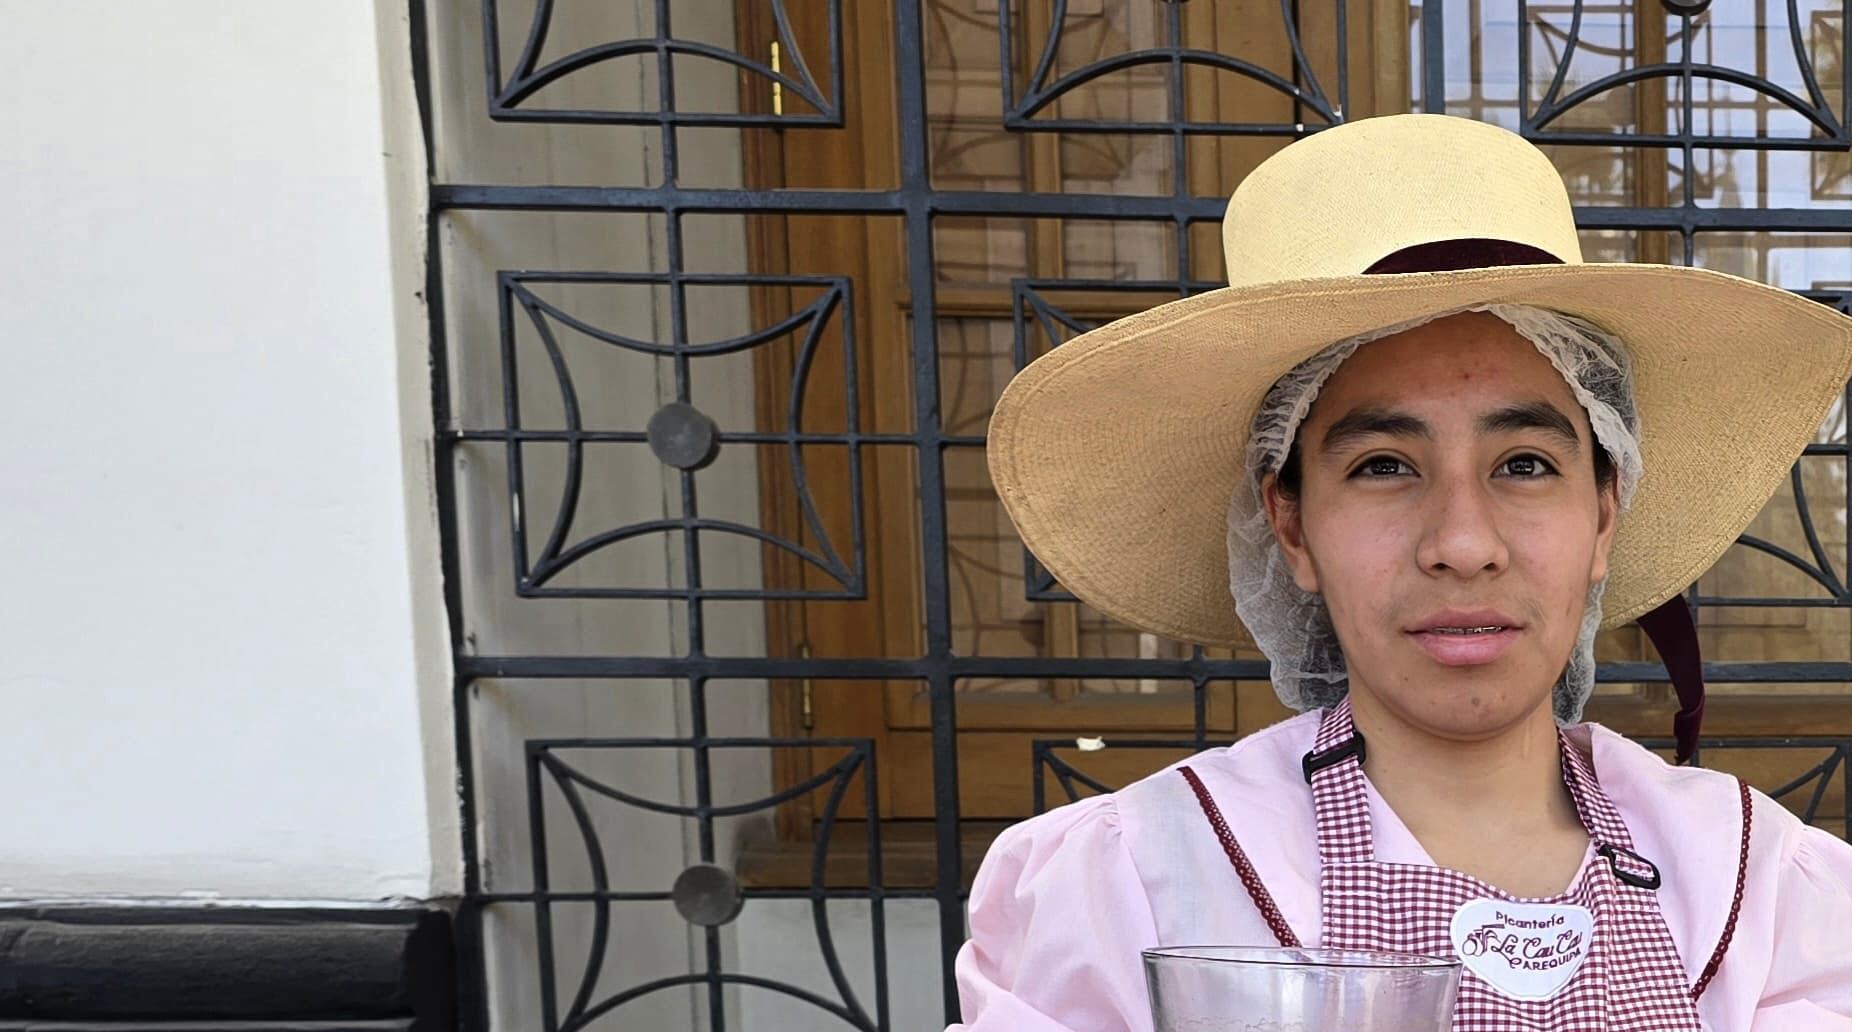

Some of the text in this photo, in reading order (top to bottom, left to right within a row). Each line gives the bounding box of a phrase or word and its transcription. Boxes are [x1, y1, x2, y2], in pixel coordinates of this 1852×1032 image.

[1496, 911, 1564, 929] Picantería
[1491, 934, 1518, 955] La
[1523, 937, 1555, 959] Cau
[1523, 947, 1581, 970] AREQUIPA
